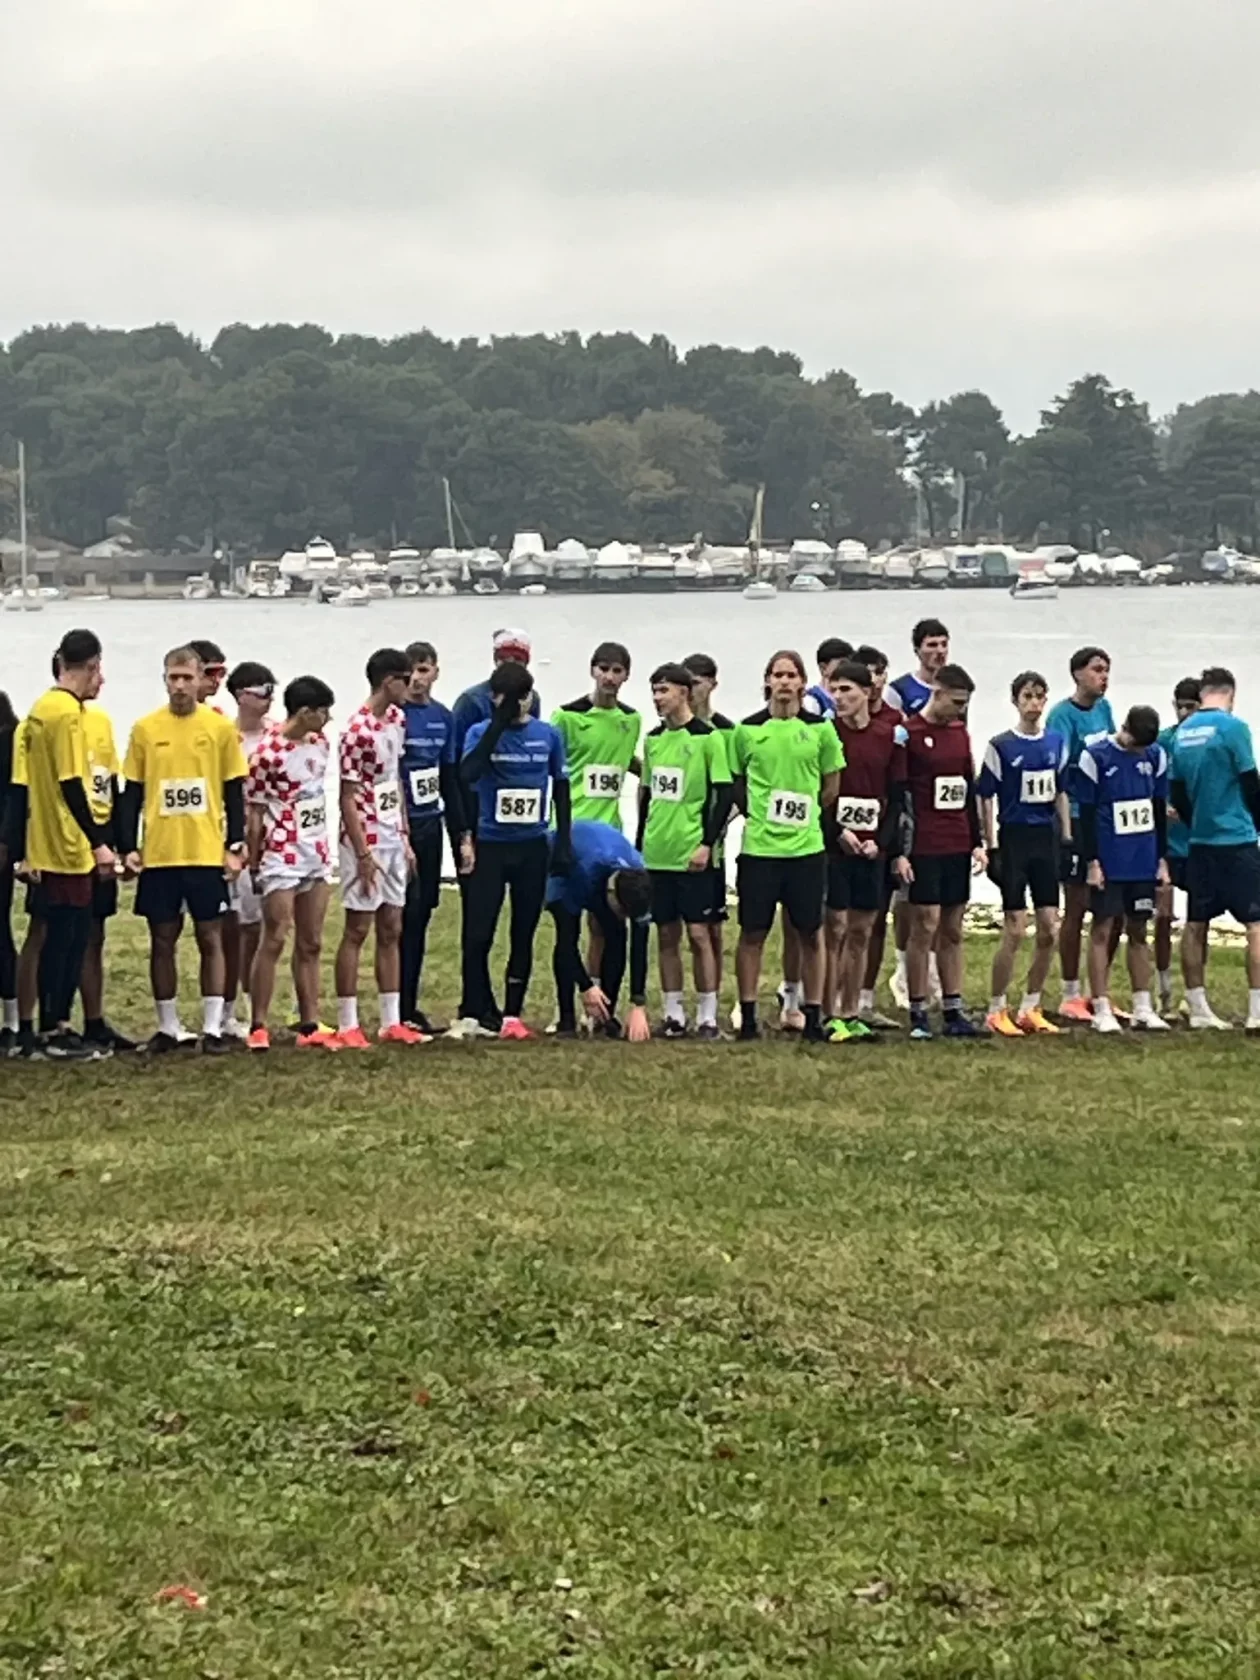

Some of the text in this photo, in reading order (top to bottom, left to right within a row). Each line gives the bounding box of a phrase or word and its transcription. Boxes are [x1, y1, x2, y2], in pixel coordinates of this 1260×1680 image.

[164, 786, 202, 808] 596
[501, 796, 537, 816] 587
[1119, 807, 1150, 827] 112
